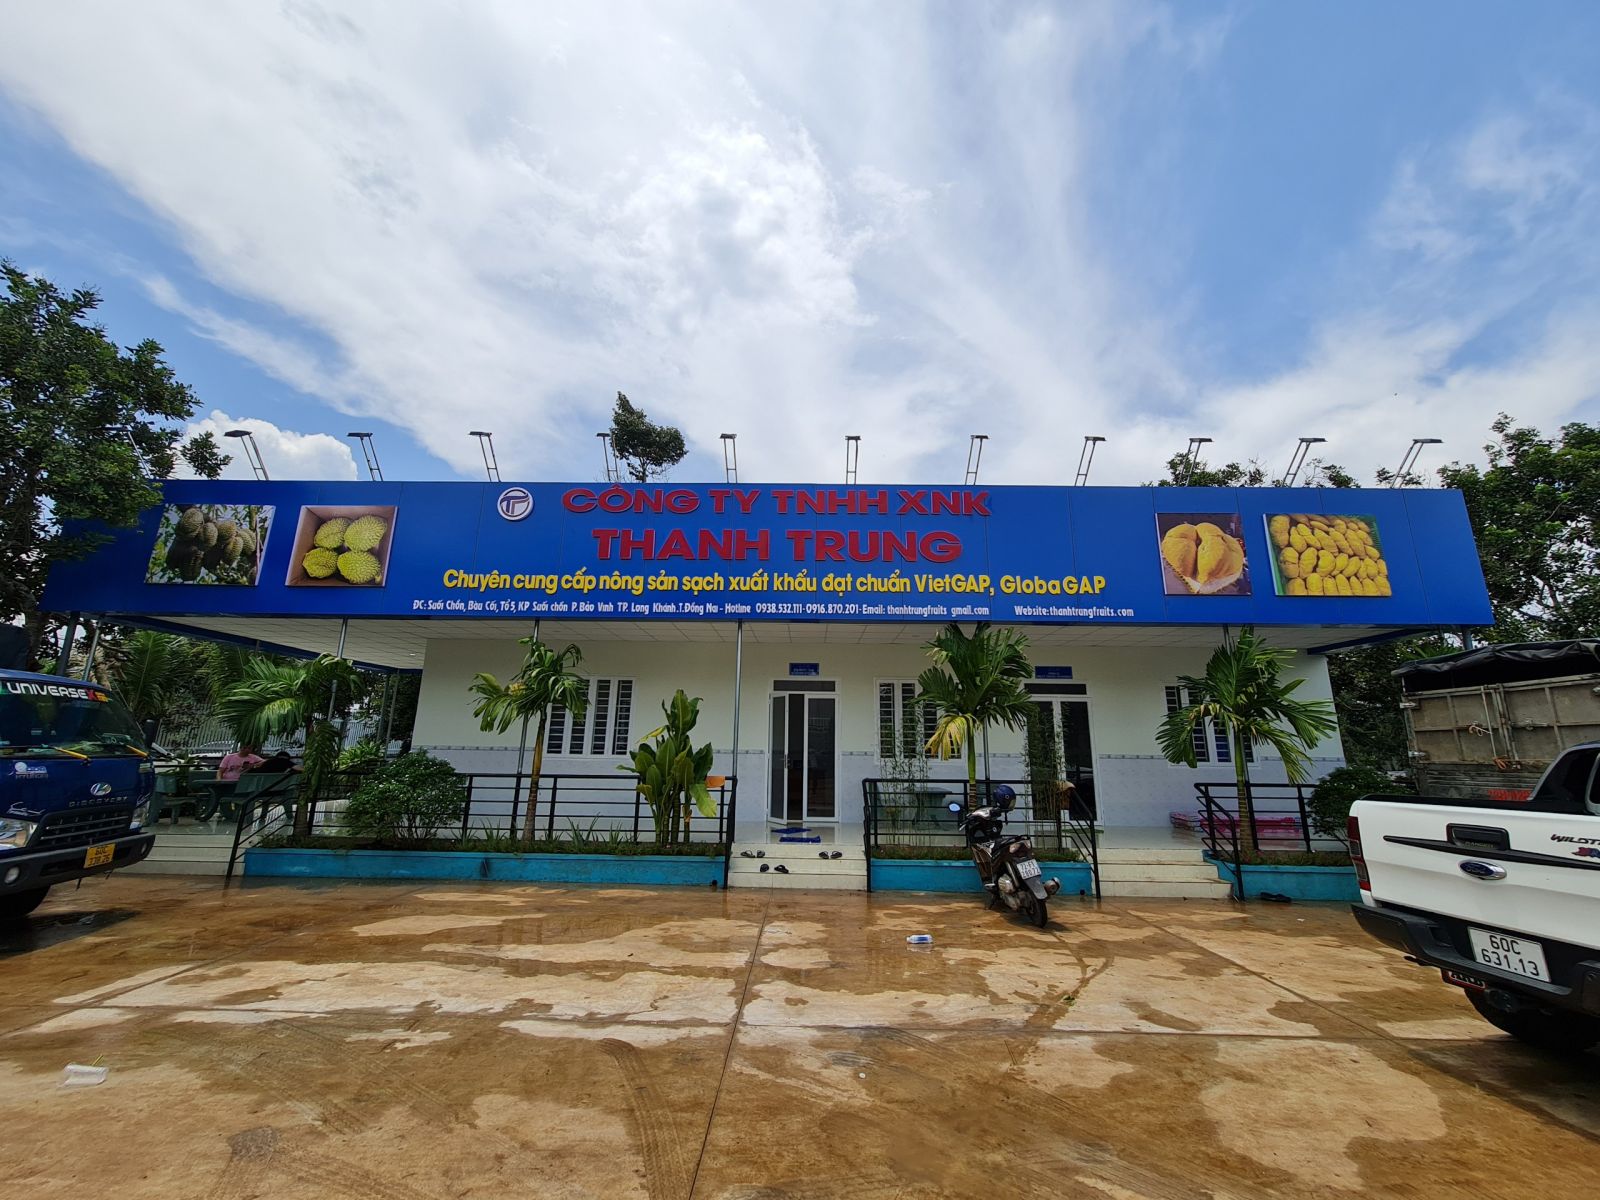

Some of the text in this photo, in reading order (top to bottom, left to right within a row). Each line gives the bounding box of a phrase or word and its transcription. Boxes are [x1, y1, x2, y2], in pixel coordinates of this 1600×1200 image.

[562, 484, 991, 516] CÔNG TY TNHH XNK
[592, 529, 963, 563] THANH TRUNG
[443, 569, 511, 592] Chuyên
[513, 573, 558, 594] cung
[561, 566, 597, 593] cấp
[599, 570, 645, 595] nông
[647, 569, 679, 591] sản
[682, 572, 724, 595] sạch
[728, 568, 769, 591] xuất
[773, 568, 817, 592] khẩu
[821, 572, 852, 596] đạt
[856, 569, 911, 593] chuẩn
[913, 573, 995, 596] VietGAP,
[518, 601, 530, 612] KP
[597, 602, 614, 613] Vinh
[617, 602, 629, 613] TP.
[631, 603, 650, 615] Long
[951, 605, 990, 617] gmail.com
[1489, 934, 1521, 955] 60C
[1481, 948, 1540, 977] 631.13
